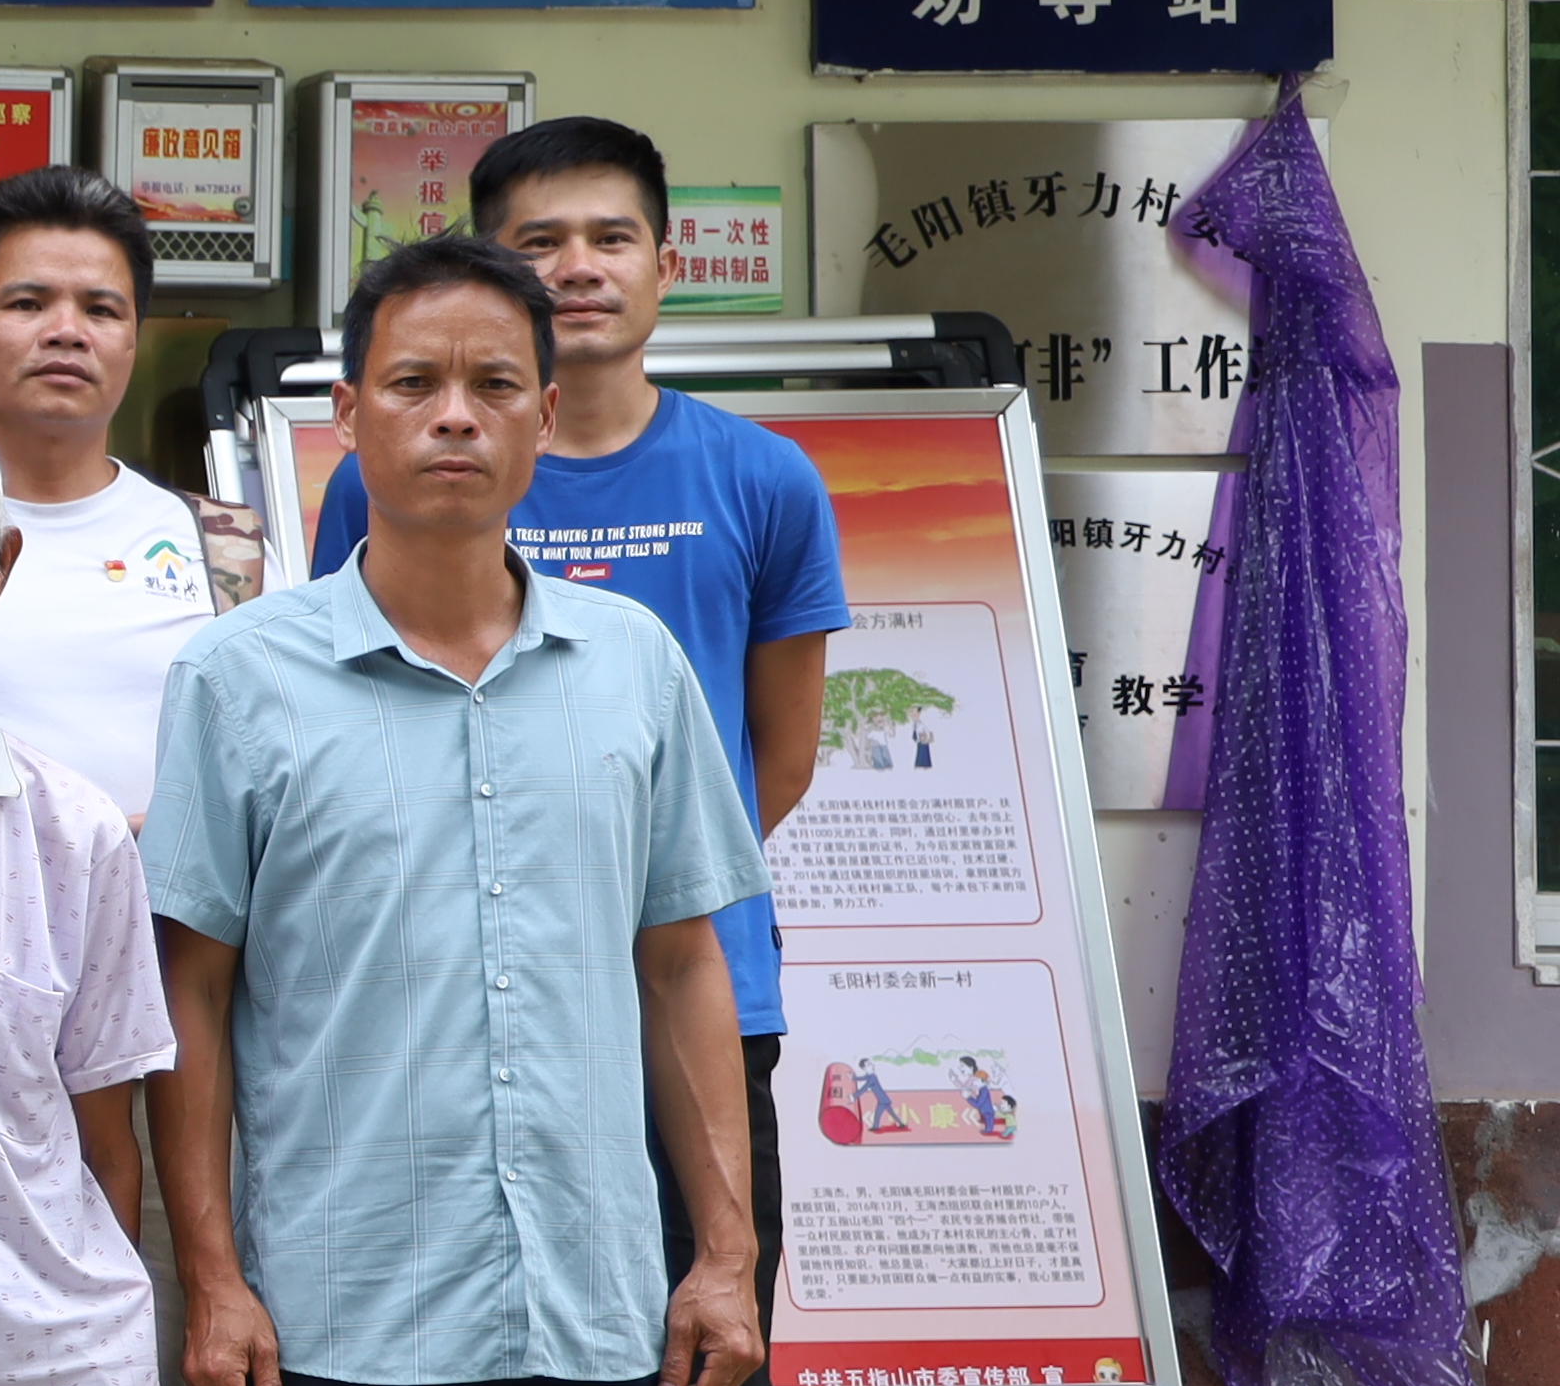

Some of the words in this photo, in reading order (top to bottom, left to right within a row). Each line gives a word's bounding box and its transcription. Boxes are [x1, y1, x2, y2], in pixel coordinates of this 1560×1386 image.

[143, 127, 242, 160] 廉政意见箱
[1141, 333, 1264, 401] 工作
[516, 527, 546, 542] TREES
[549, 527, 588, 543] WAVING
[591, 527, 604, 542] IN
[607, 526, 626, 541] THE
[628, 524, 666, 540] STRONG
[668, 521, 704, 537] BREEZE
[542, 545, 568, 560] WHAT
[570, 544, 592, 560] YOUR
[594, 544, 623, 559] HEART
[625, 543, 649, 558] TELLS
[652, 541, 670, 556] YOU
[828, 970, 973, 990] 毛阳村委会新一村
